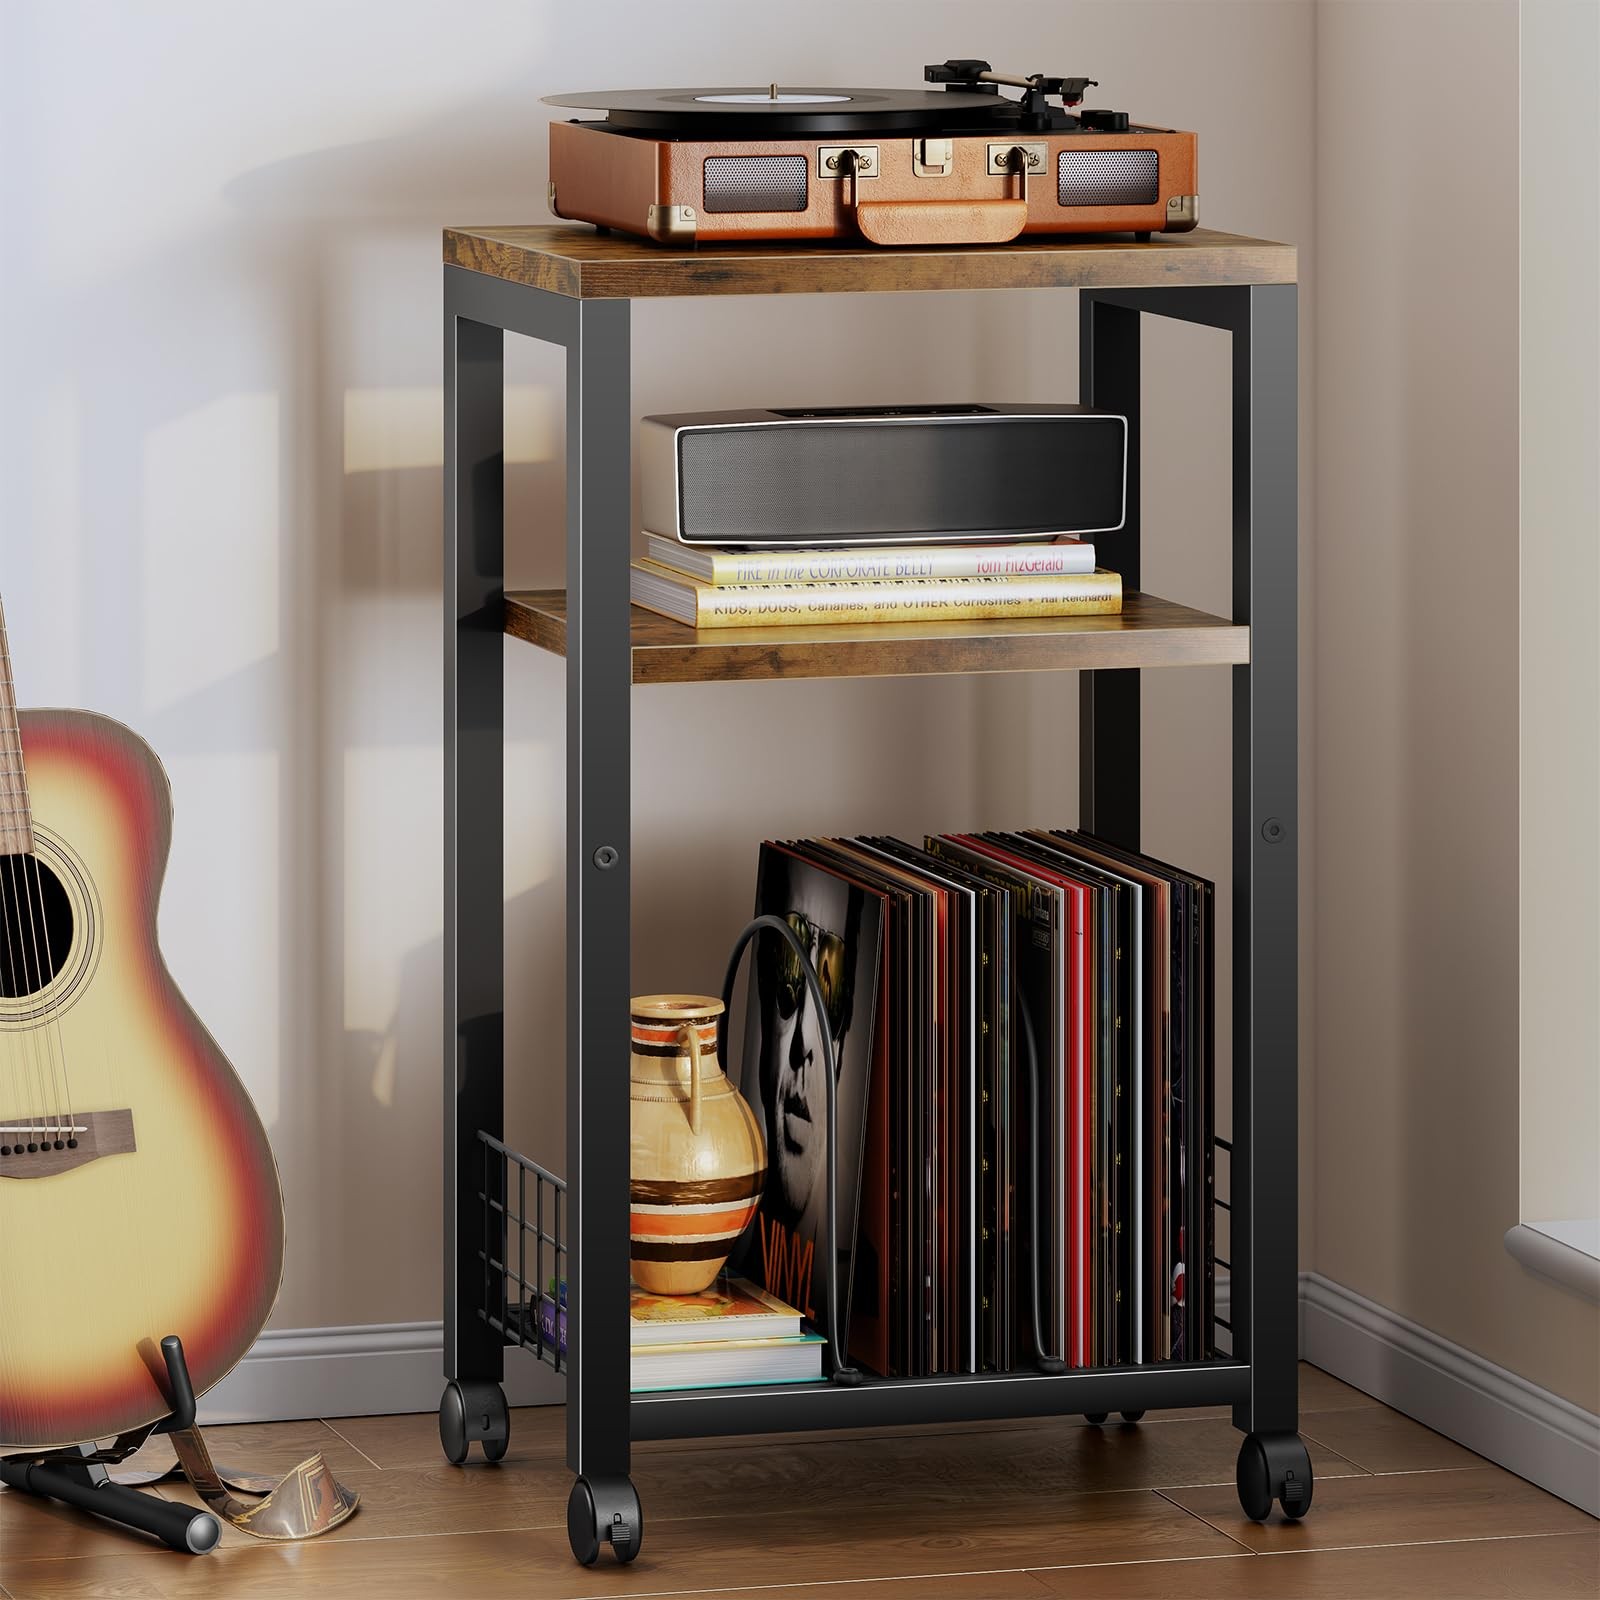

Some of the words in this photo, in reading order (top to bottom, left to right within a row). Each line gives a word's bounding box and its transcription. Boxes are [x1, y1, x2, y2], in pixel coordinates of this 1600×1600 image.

[736, 560, 763, 581] FIRE
[767, 559, 781, 580] in
[783, 558, 805, 580] the
[809, 556, 890, 579] CORPORATE
[895, 555, 936, 576] BELLY
[976, 554, 1001, 574] Tom
[714, 600, 752, 615] KIDS,
[758, 600, 802, 614] DOGS,
[873, 597, 897, 610] and
